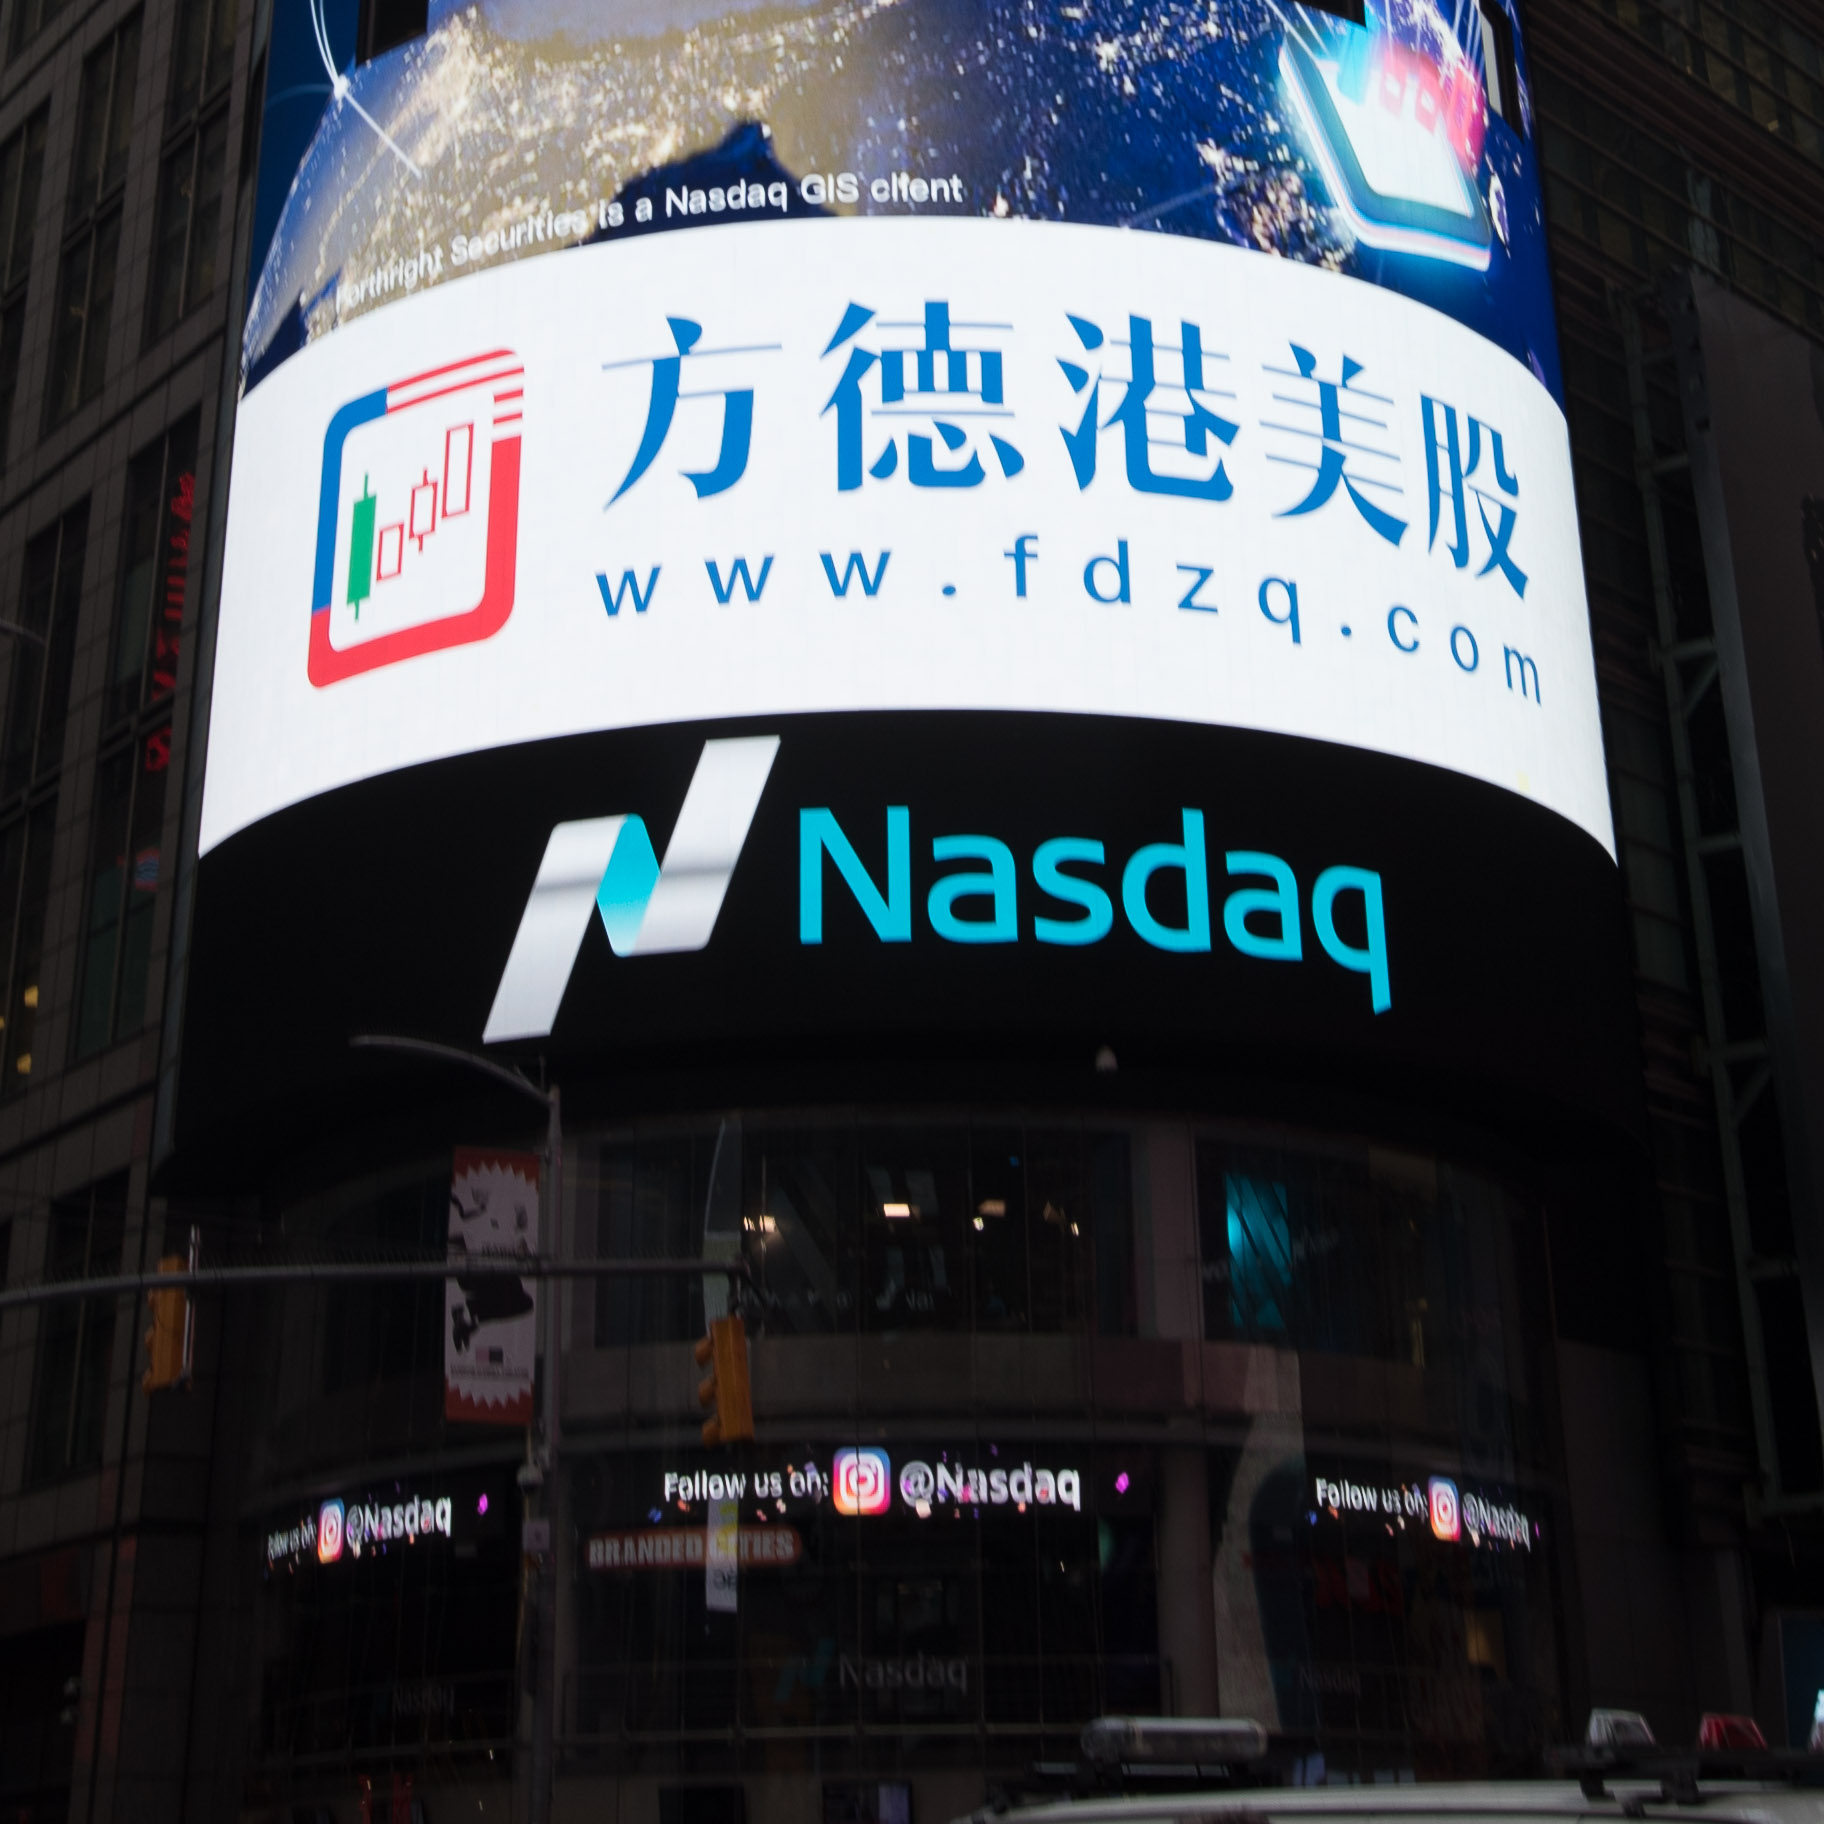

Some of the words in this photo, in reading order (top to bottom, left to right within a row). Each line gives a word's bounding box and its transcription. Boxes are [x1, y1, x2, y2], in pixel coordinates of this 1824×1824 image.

[450, 207, 590, 267] Securities
[599, 198, 625, 229] is
[634, 196, 653, 223] a
[664, 177, 788, 219] Nasdaq
[800, 172, 860, 206] GIS
[870, 171, 964, 204] client
[598, 299, 1532, 601] 方德港美股
[594, 533, 1547, 707] www.fdzq.com
[798, 805, 1393, 1014] Nasdaq
[664, 1469, 746, 1503] Follow
[753, 1471, 783, 1499] us
[899, 1460, 1082, 1512] @Nasdaq
[1315, 1477, 1378, 1513] Follow
[1380, 1487, 1402, 1515] us
[346, 1493, 453, 1552] @Nasdaq
[588, 1532, 704, 1570] BRANDED
[838, 1651, 968, 1696] Nasdaq
